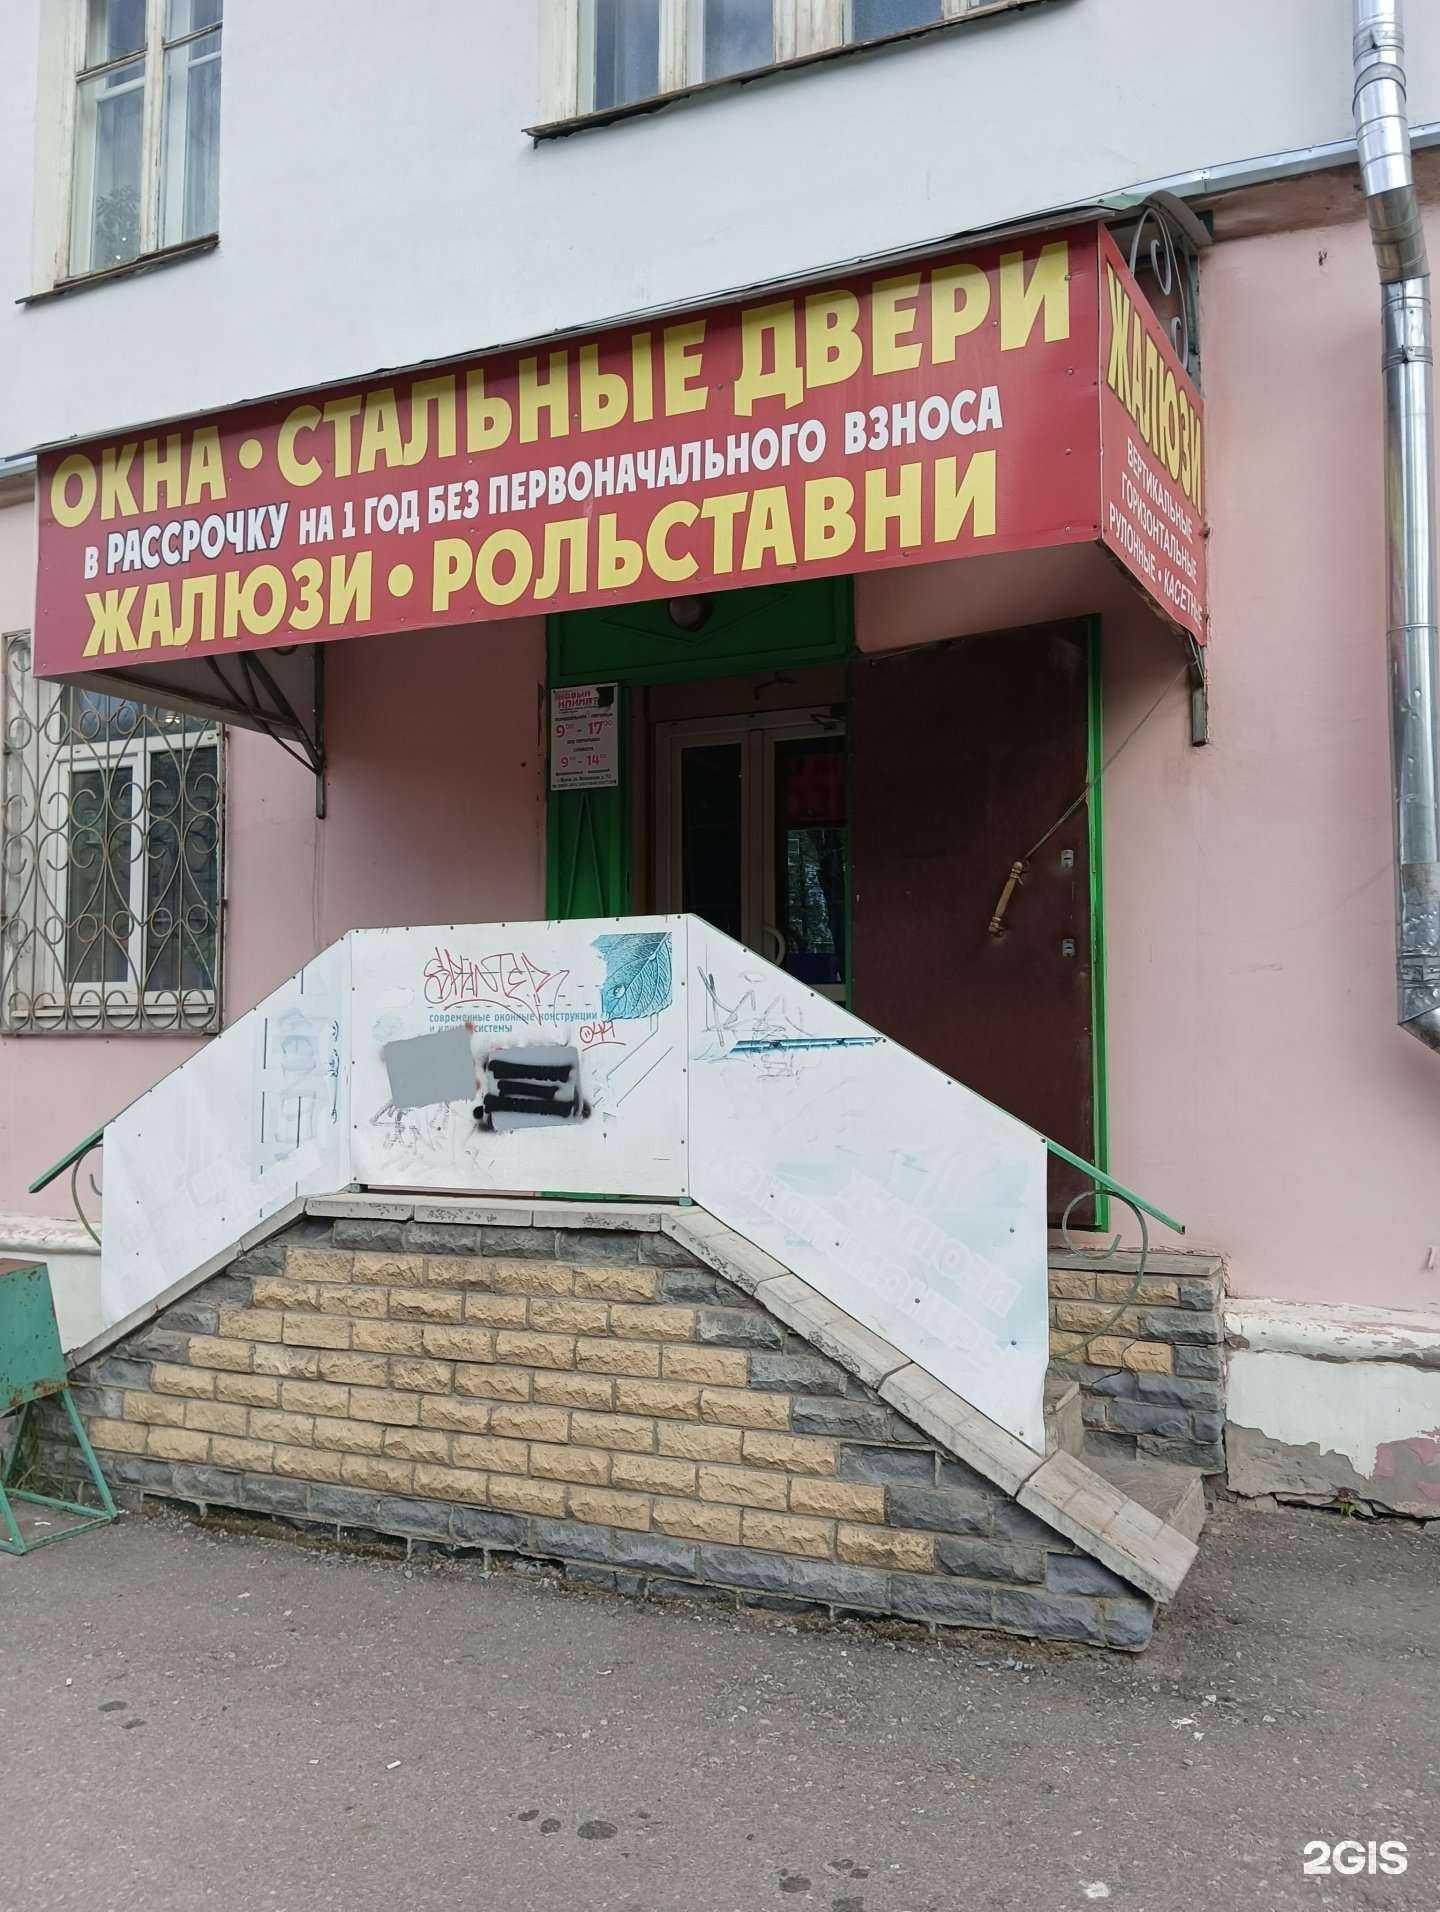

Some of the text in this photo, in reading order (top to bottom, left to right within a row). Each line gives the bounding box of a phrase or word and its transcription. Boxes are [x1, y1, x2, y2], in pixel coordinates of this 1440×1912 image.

[50, 241, 1070, 527] ОКНА СТАЛЬНЫЕ ДВЕРИ
[1107, 262, 1202, 517] ЖАЛЮЗИ
[106, 502, 289, 574] РАССРОЧКУ
[299, 504, 333, 545] НА
[343, 501, 355, 537] 1
[364, 488, 419, 535] ГОД
[428, 480, 479, 524] БЕЗ
[488, 419, 826, 515] ПЕРВОНАЧАЛЬНОГО
[844, 385, 1003, 455] ВЗНОСА
[1121, 471, 1197, 584] ГОРИЗОНТАЛЬНЫЕ
[1127, 436, 1193, 544] ВЕРТИКАЛЬНЫЕ
[82, 449, 997, 657] ЖАЛЮЗИ РОЛЬСТАВНИ
[1109, 501, 1156, 583] РУЛОННЫЕ
[429, 1013, 491, 1023] современные
[473, 1025, 512, 1033] системы
